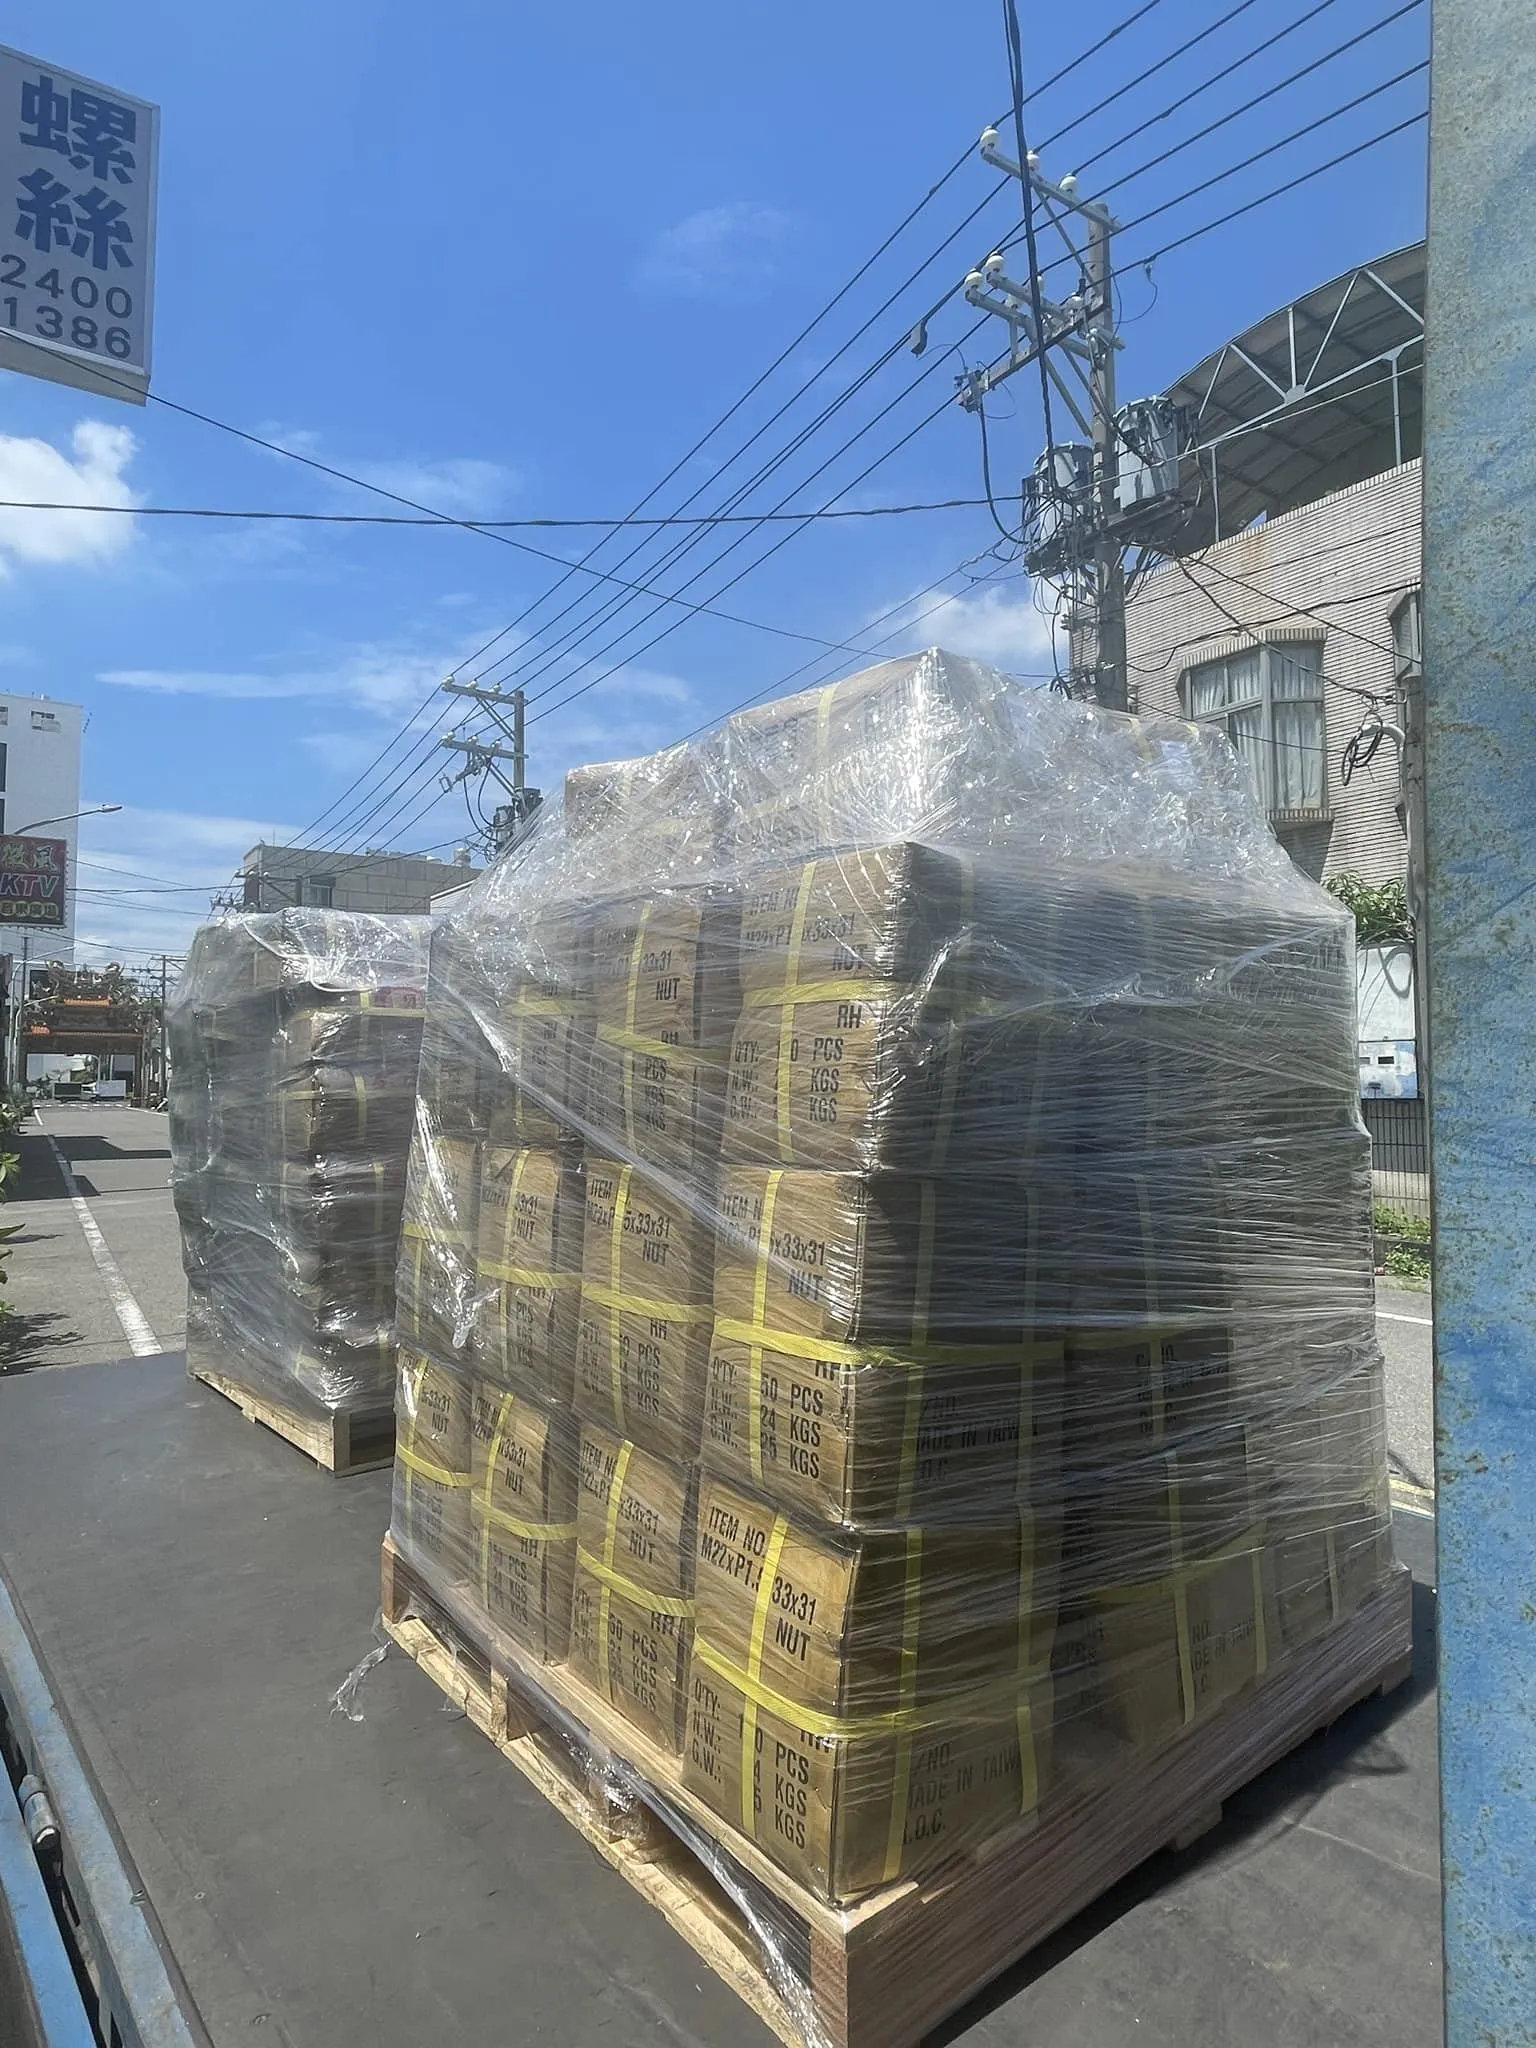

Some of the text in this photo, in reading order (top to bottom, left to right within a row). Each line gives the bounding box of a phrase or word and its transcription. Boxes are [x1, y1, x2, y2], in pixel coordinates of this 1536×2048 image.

[16, 75, 137, 271] 螺絲
[0, 253, 133, 319] 2400
[6, 297, 132, 359] 1386
[0, 872, 60, 898] KTV
[655, 977, 681, 1000] NUT
[837, 1005, 862, 1029] RH
[813, 1037, 844, 1062] PCS
[810, 1067, 840, 1093] KGS
[809, 1096, 838, 1124] KGS
[642, 1239, 669, 1267] NUT
[637, 1343, 661, 1370] PCS
[789, 1383, 824, 1417] PCS
[431, 1411, 449, 1435] NUT
[789, 1413, 821, 1448] KGS
[789, 1445, 820, 1479] KGS
[504, 1466, 525, 1497] NUT
[628, 1529, 657, 1564] NUT
[708, 1506, 766, 1560] ITEM NO.
[631, 1630, 659, 1663] PCS
[775, 1617, 811, 1661] NUT
[632, 1655, 657, 1689] KGS
[775, 1740, 810, 1785] PCS
[956, 1763, 973, 1793] IN
[774, 1773, 807, 1818] KGS
[774, 1803, 806, 1850] KGS
